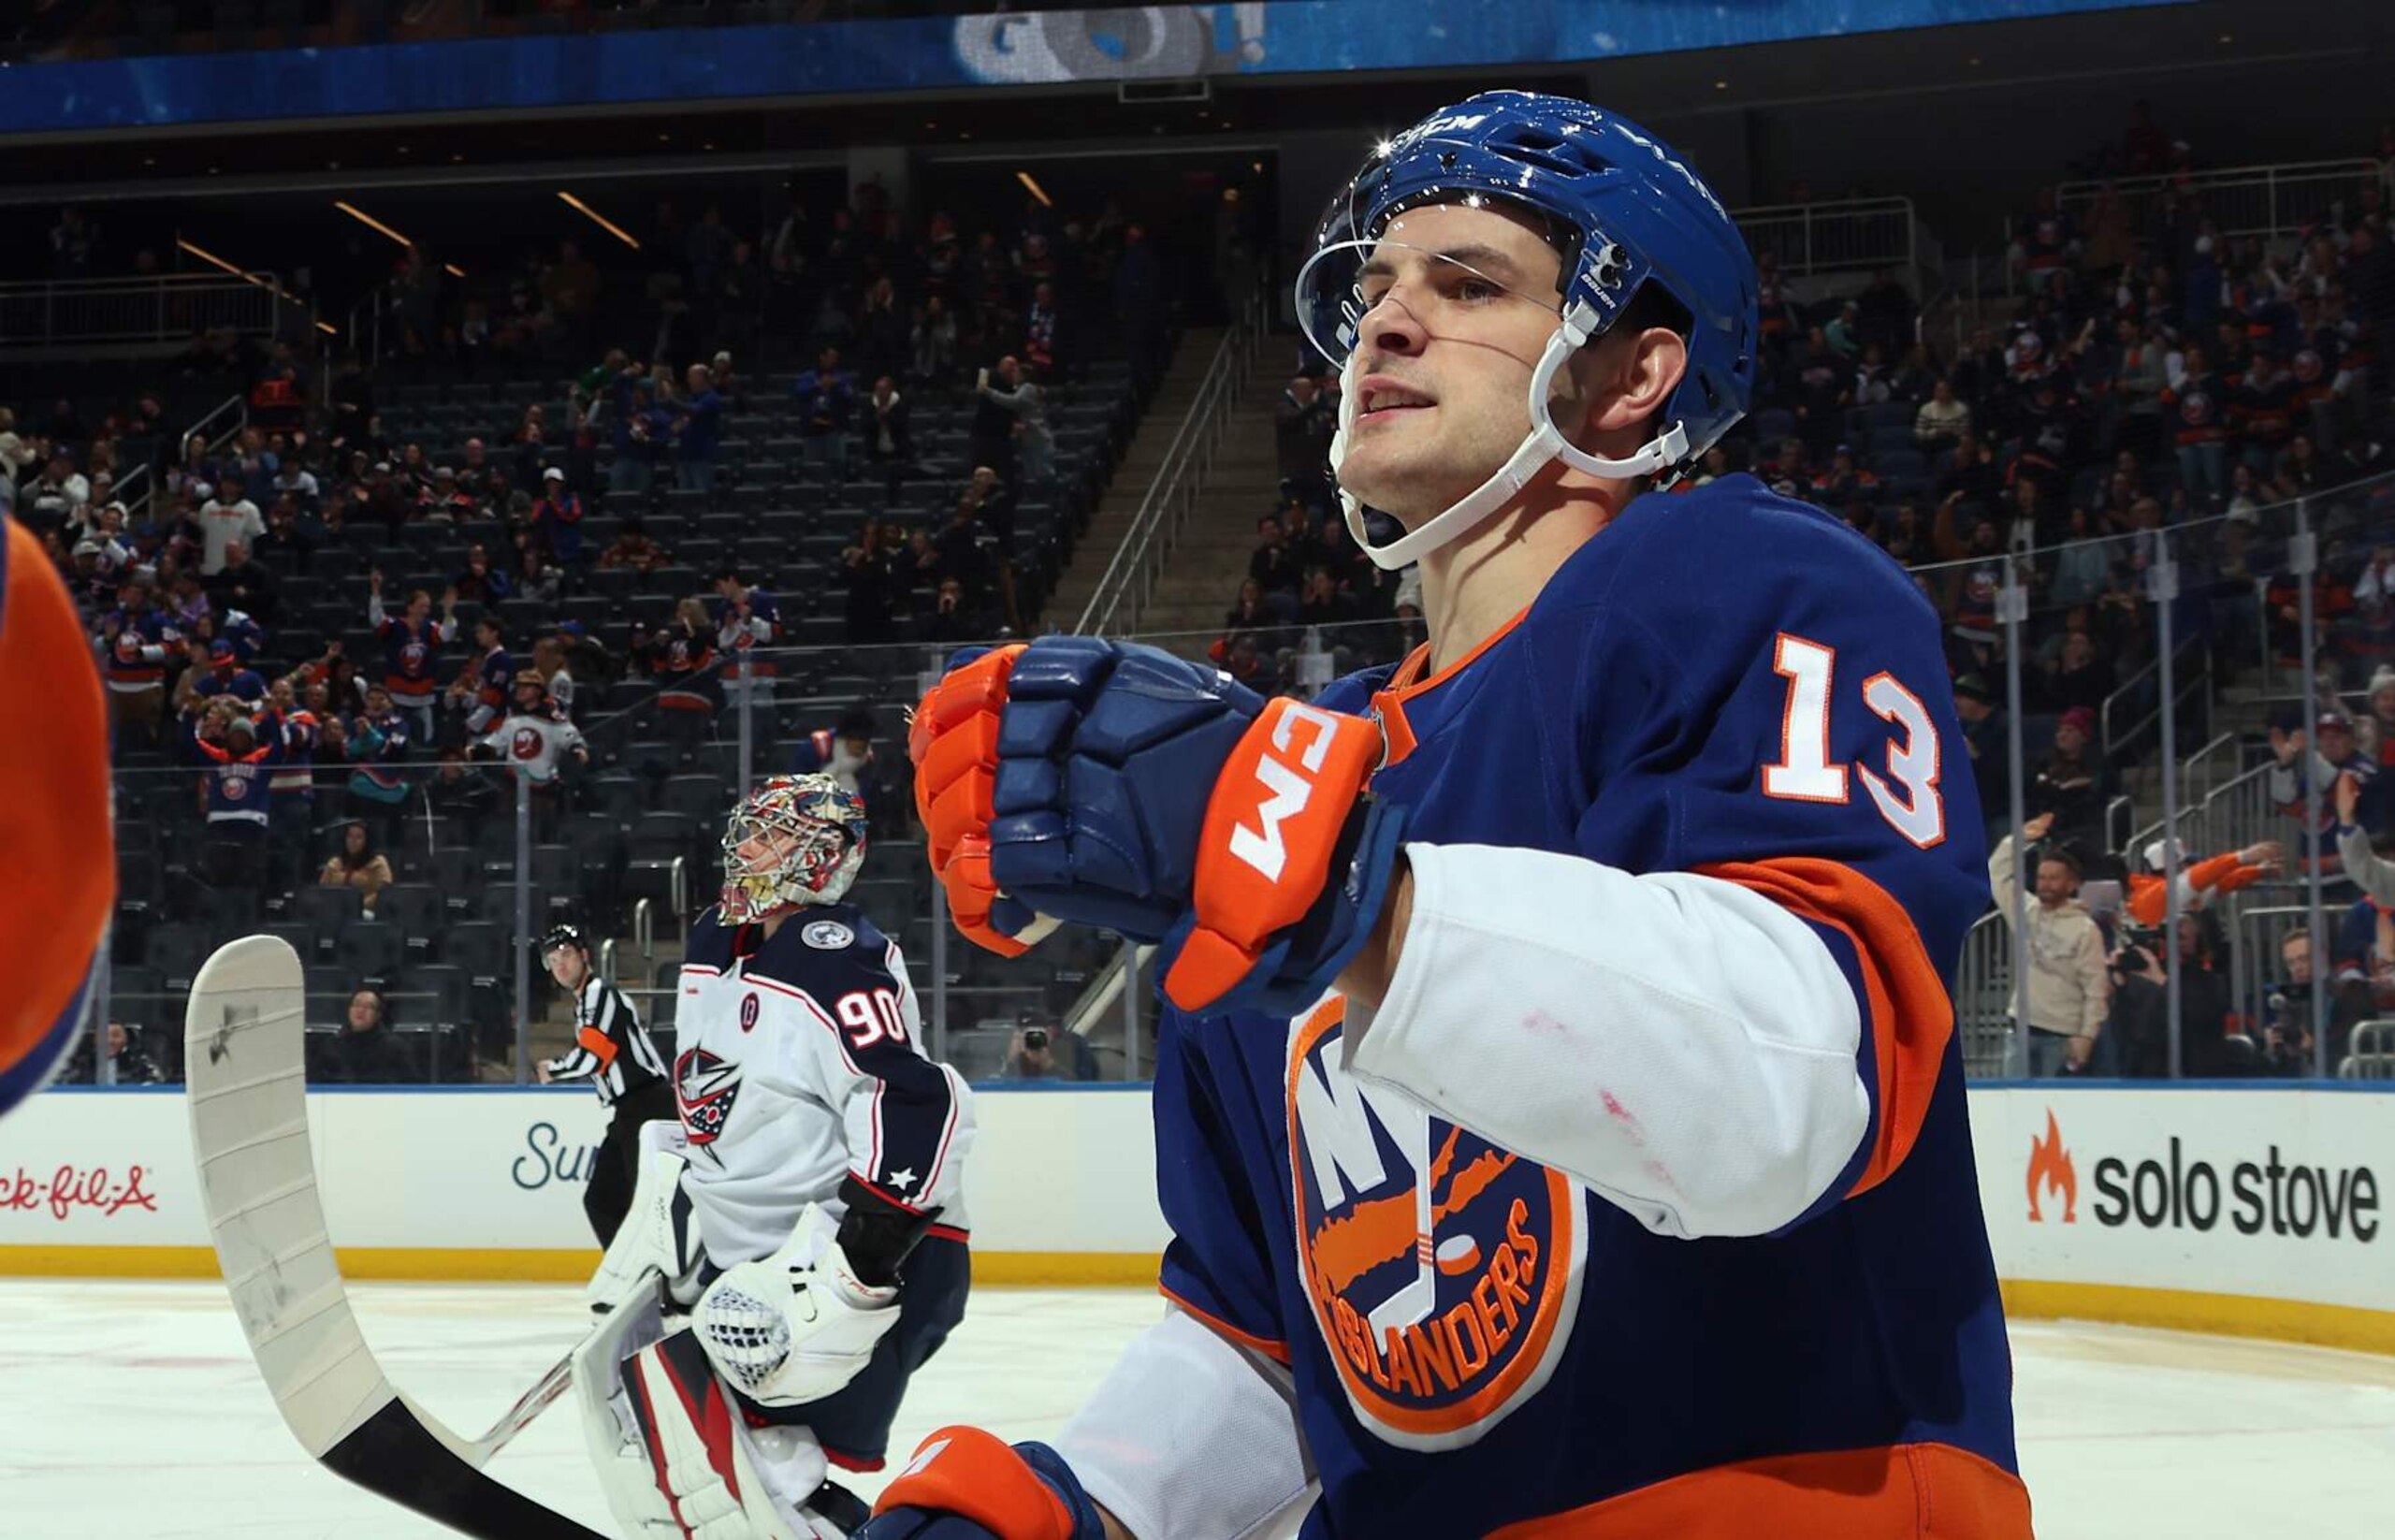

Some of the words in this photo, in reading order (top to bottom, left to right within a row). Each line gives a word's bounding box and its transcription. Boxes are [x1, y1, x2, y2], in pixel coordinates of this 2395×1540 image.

[1580, 273, 1617, 310] BAUER
[1762, 631, 1947, 850] 13
[835, 987, 908, 1049] 90
[2093, 1136, 2220, 1232] solo
[2231, 1144, 2380, 1243] stove
[1330, 1198, 1539, 1397] ISLANDERS
